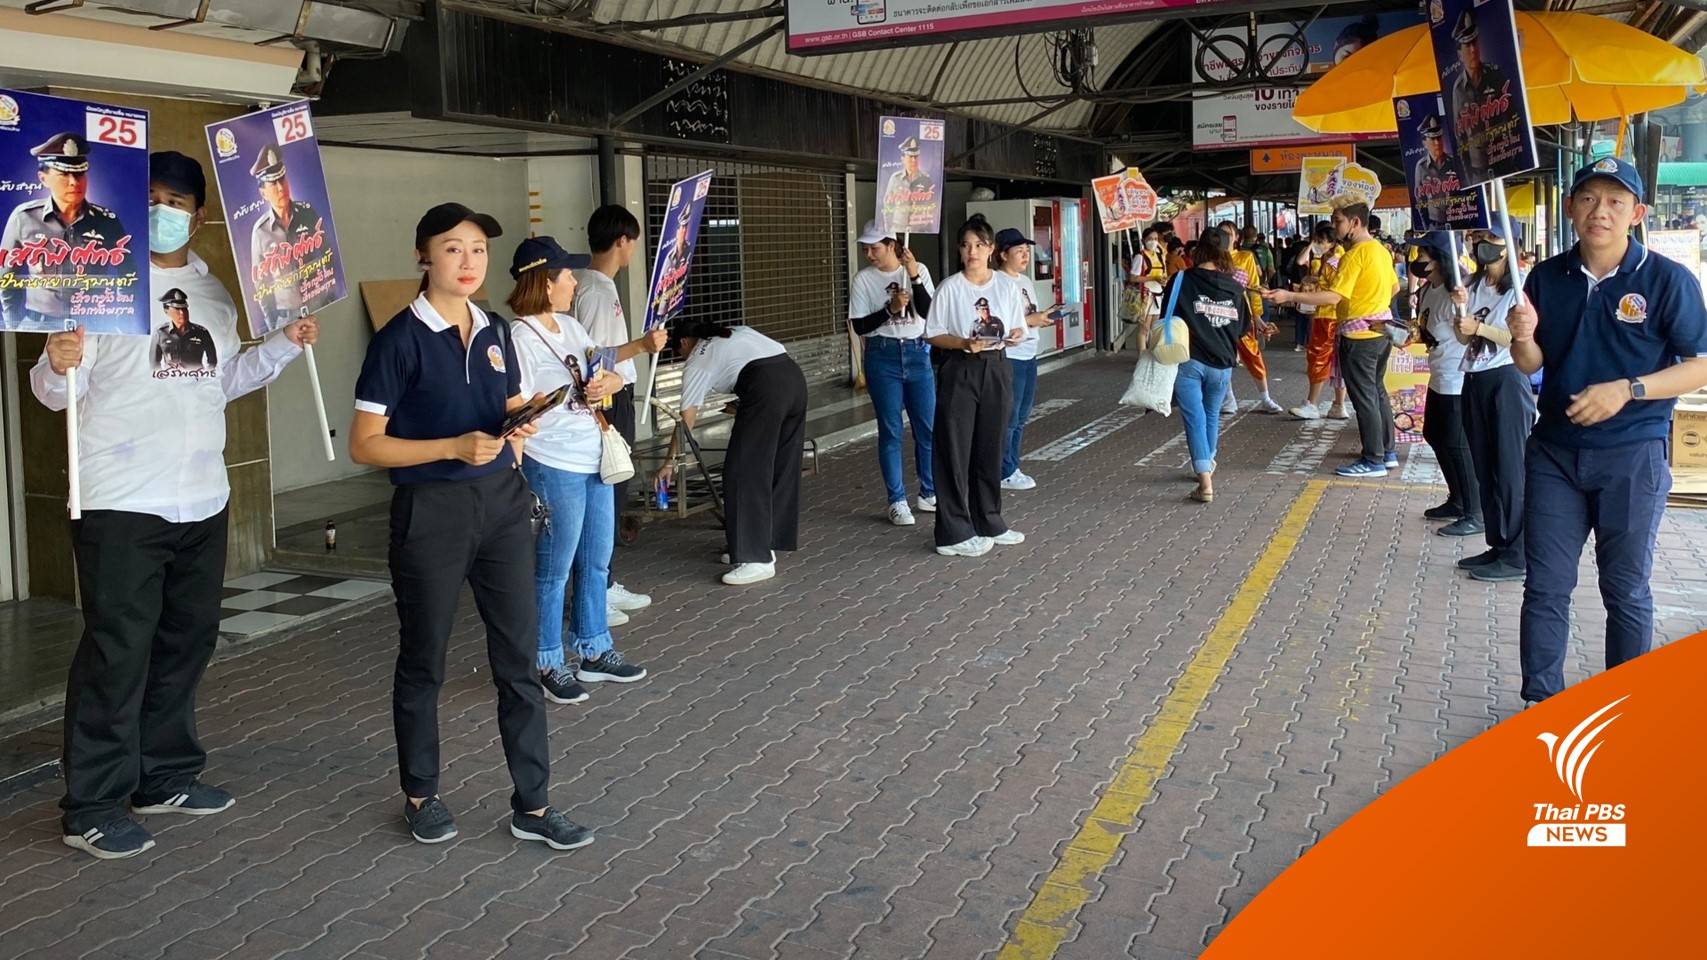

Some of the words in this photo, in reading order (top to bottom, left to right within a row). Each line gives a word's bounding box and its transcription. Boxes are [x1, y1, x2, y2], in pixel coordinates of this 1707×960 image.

[852, 29, 867, 39] GSB
[867, 26, 894, 37] Contact
[894, 25, 917, 34] Center
[918, 23, 935, 31] 1115
[98, 117, 137, 145] 25
[282, 113, 307, 142] 25
[924, 126, 940, 139] 25
